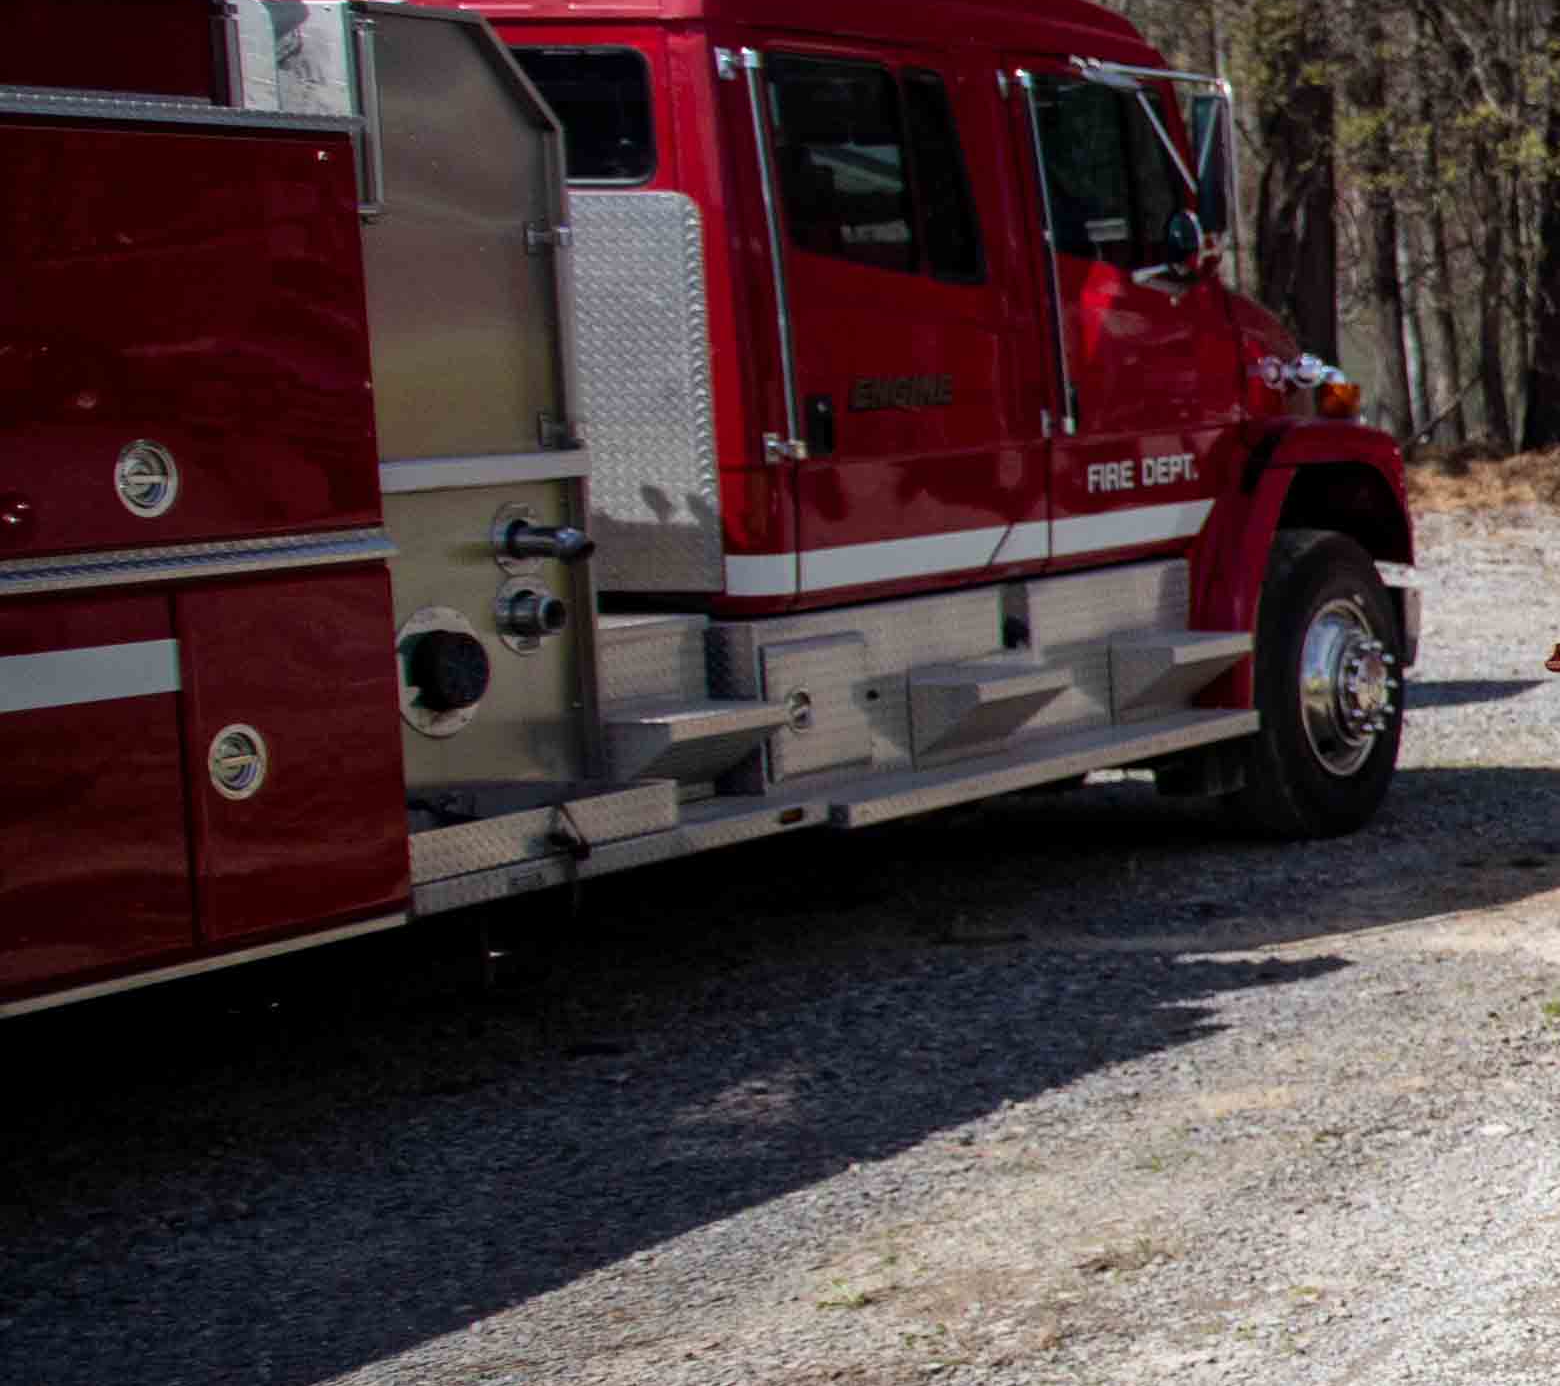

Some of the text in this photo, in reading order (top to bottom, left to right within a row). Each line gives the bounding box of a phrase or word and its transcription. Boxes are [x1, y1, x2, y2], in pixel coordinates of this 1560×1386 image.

[849, 374, 953, 410] ENGINE
[1087, 453, 1199, 493] FIRE DEPT.
